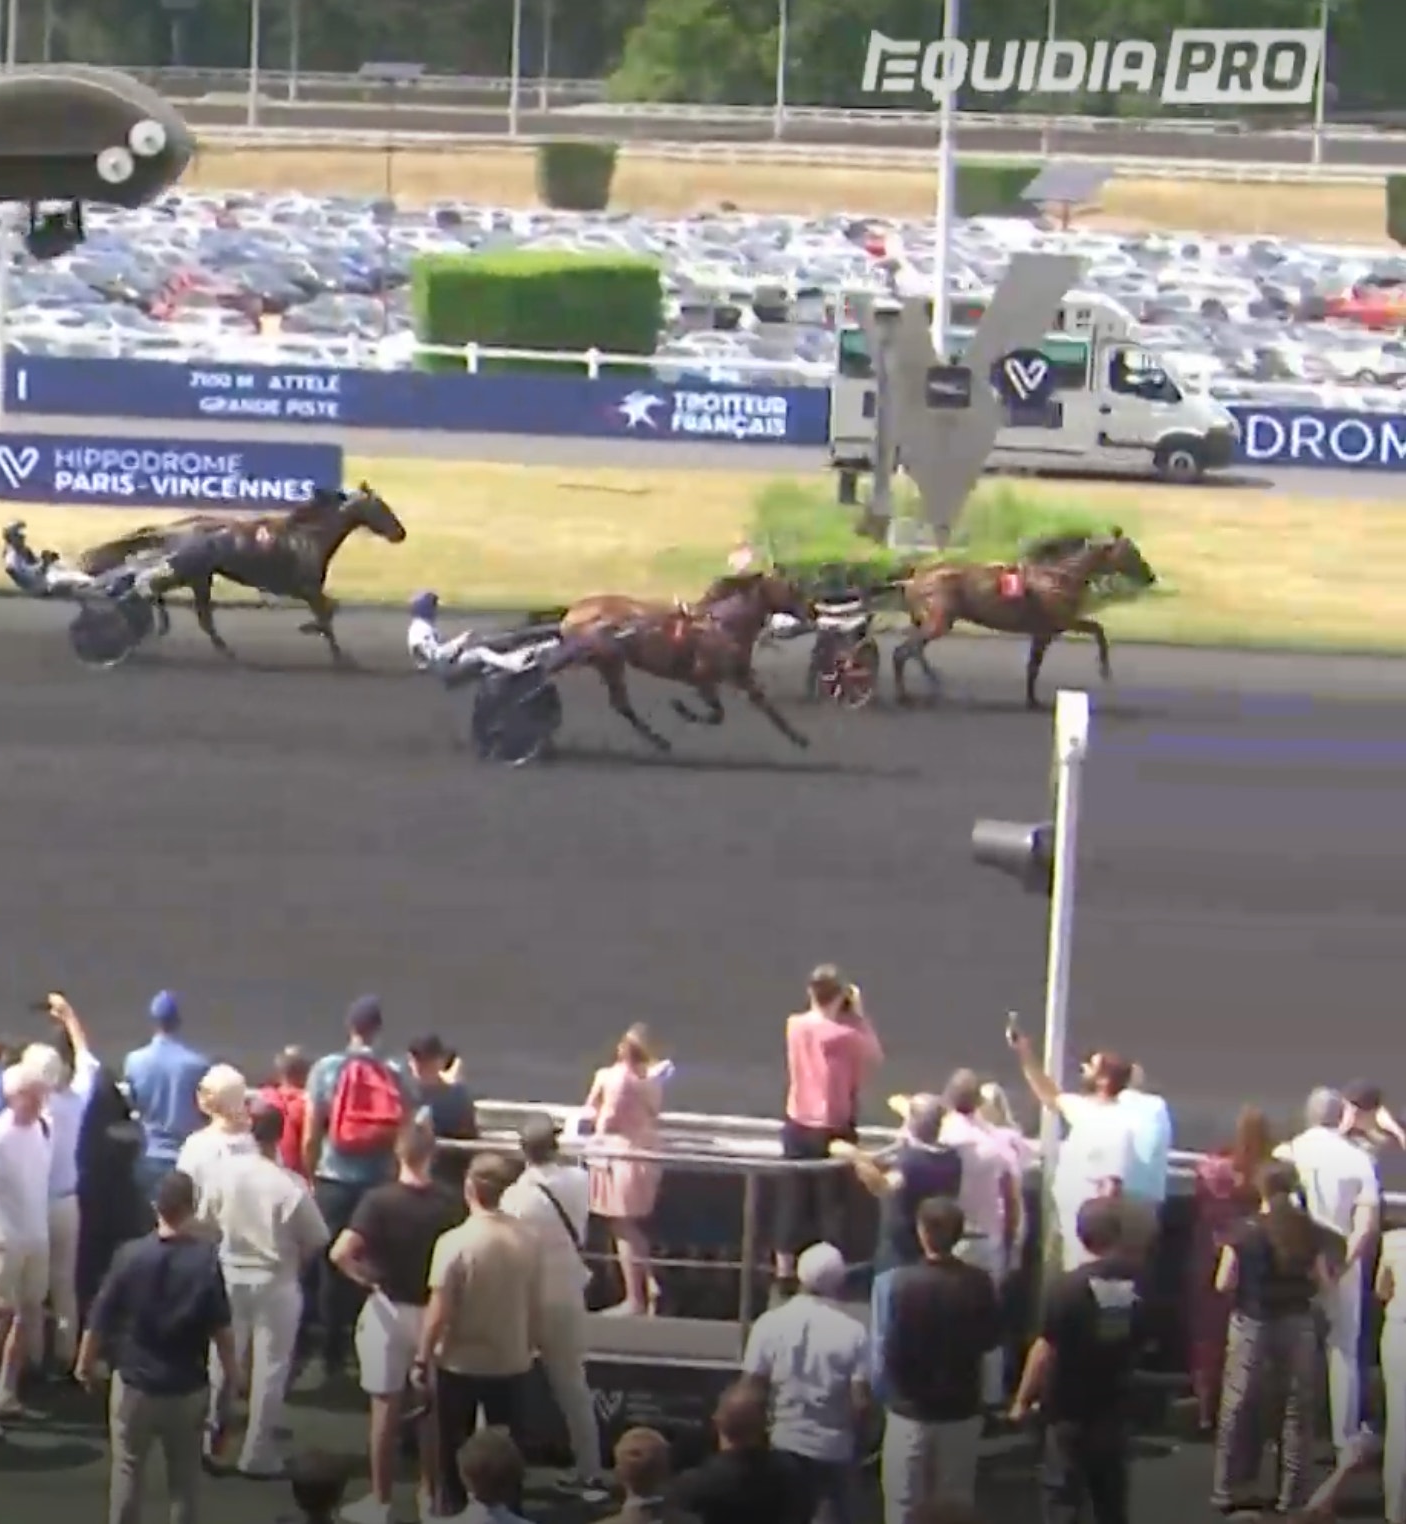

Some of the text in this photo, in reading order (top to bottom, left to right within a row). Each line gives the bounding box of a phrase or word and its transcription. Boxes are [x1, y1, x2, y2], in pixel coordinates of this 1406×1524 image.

[673, 391, 787, 413] TROTTEUR
[671, 413, 786, 438] FRANÇAIS
[53, 447, 244, 474] HIPPODROME
